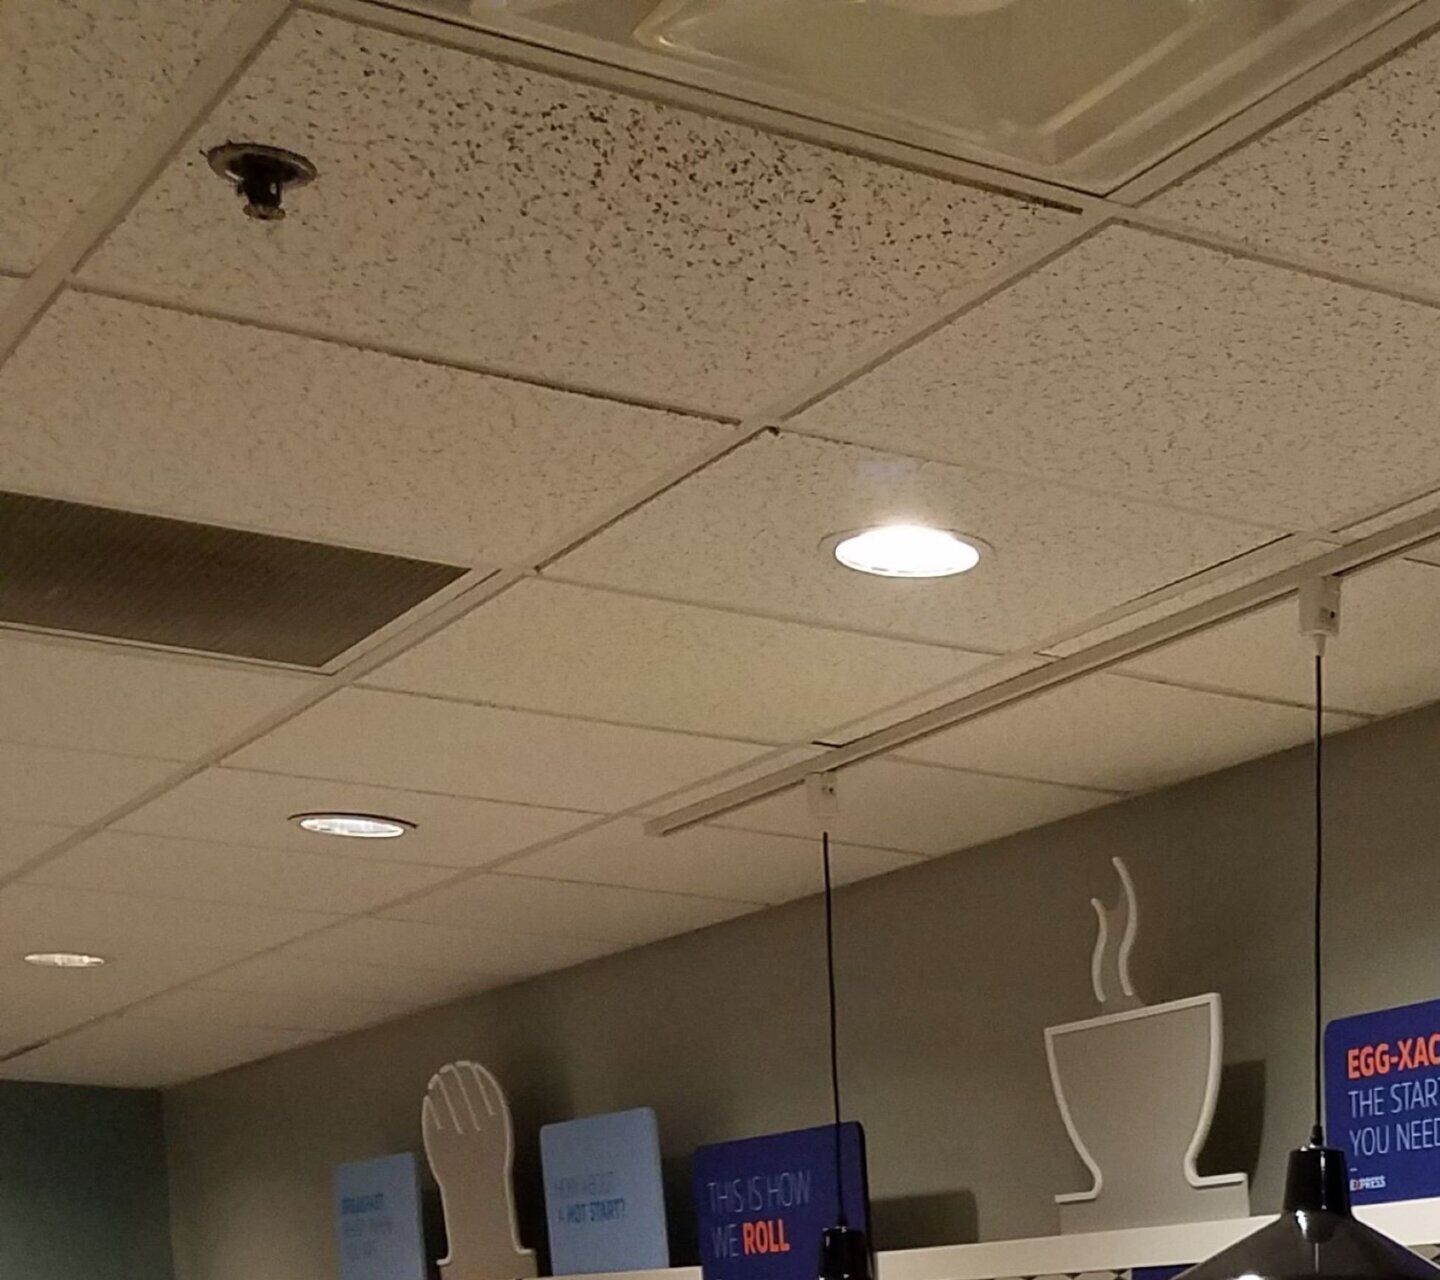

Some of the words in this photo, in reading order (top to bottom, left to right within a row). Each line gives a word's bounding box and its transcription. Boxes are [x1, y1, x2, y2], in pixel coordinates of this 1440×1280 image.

[1348, 1085, 1385, 1119] THE
[1349, 1125, 1390, 1157] YOU
[706, 1178, 744, 1214] THIS
[746, 1175, 763, 1212] IS
[766, 1170, 812, 1208] HOW
[712, 1223, 740, 1259] WE
[742, 1217, 791, 1256] ROLL
